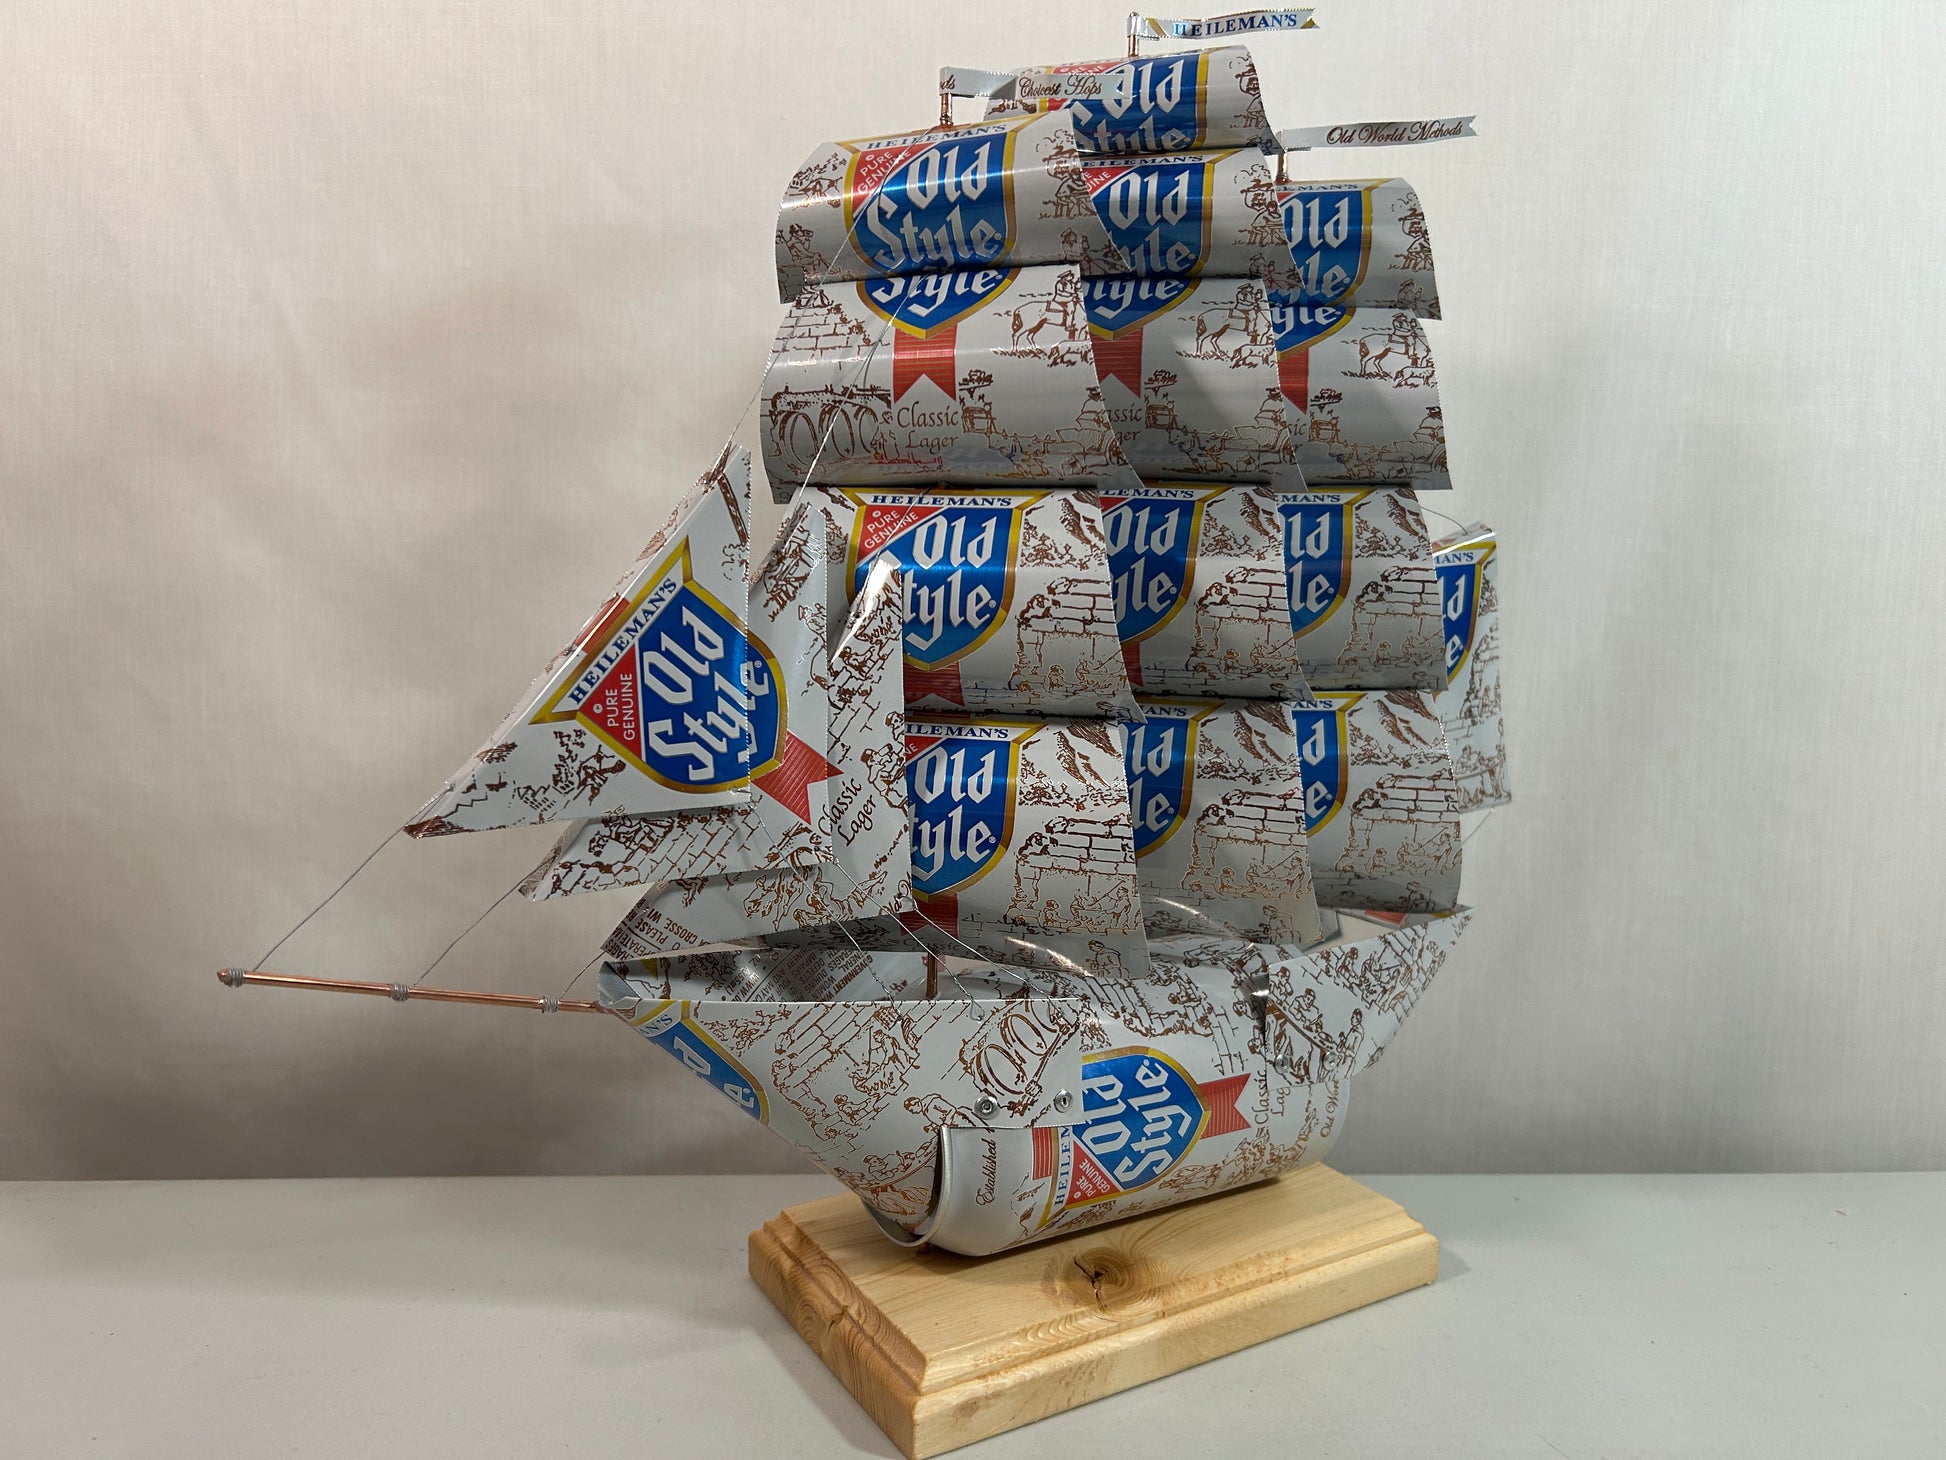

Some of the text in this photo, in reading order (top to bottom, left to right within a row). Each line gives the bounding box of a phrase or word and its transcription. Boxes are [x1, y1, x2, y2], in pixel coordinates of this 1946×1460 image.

[1173, 13, 1297, 37] HEILEMAN'S
[1019, 74, 1102, 99] Choicest Hops
[866, 123, 1007, 150] HEILEMAN'S
[1326, 120, 1463, 145] Old World Methods
[860, 152, 894, 177] PURE
[907, 142, 992, 210] Old
[1083, 155, 1203, 167] EILEMAN'S
[1108, 170, 1190, 231] Old
[866, 193, 999, 270] Style
[1280, 197, 1349, 249] Old
[1270, 306, 1337, 340] yle
[897, 400, 959, 428] Classic
[905, 430, 958, 455] Lager
[1115, 430, 1140, 446] ger
[871, 495, 1012, 507] HEILEMAN'S
[1103, 489, 1194, 499] LEMAN'S
[866, 510, 900, 534] PURE
[1102, 505, 1180, 556] Old
[1281, 512, 1330, 560] ld
[912, 515, 997, 570] Old
[567, 577, 677, 705] HEILEMAN'S
[643, 605, 724, 705] Old
[605, 688, 619, 727] PURE
[620, 673, 636, 741] GENUINE
[648, 660, 769, 781] Style
[905, 724, 1009, 738] ILEMAN'S
[914, 747, 996, 804] Old
[818, 777, 862, 836] Classic
[837, 794, 877, 847] Lager
[908, 804, 993, 882] tyle
[634, 918, 669, 945] PLEASE
[647, 908, 663, 923] WI
[665, 917, 698, 946] CROSSE,
[1081, 1075, 1131, 1155] Old
[1113, 1062, 1192, 1183] Style
[1321, 1115, 1334, 1138] Old
[976, 1137, 997, 1206] Established
[1078, 1176, 1097, 1197] PURE
[1079, 1158, 1110, 1194] GENUINE
